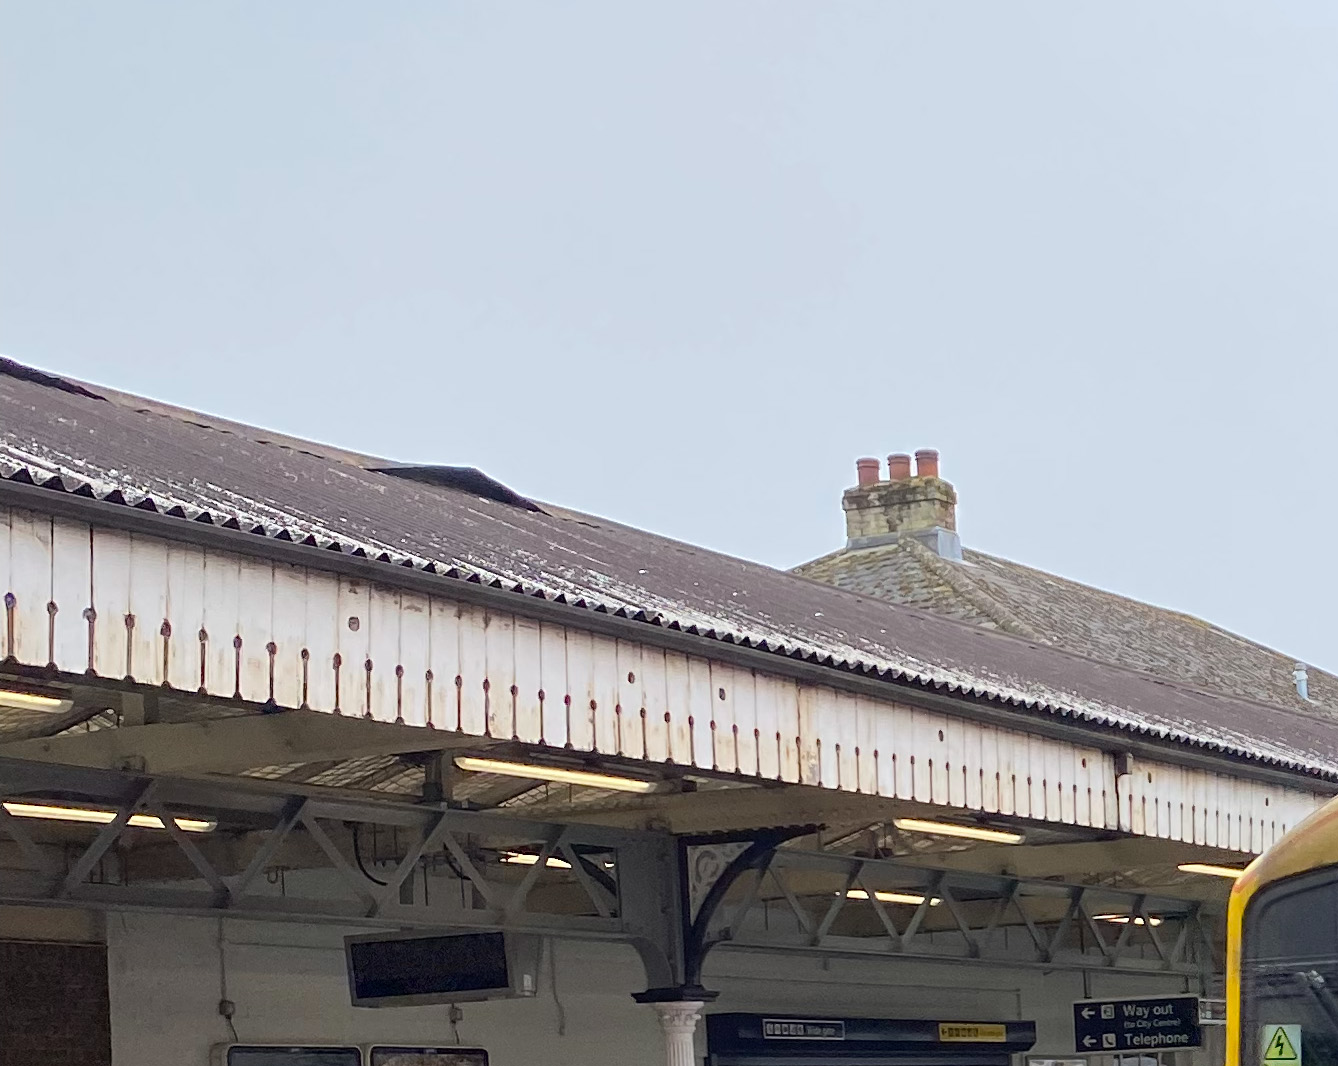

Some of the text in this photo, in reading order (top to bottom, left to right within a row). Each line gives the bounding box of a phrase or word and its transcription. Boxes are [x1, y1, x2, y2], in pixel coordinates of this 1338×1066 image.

[1122, 1003, 1174, 1018] Way out
[1136, 1019, 1151, 1029] City
[1123, 1032, 1189, 1047] Telephone
